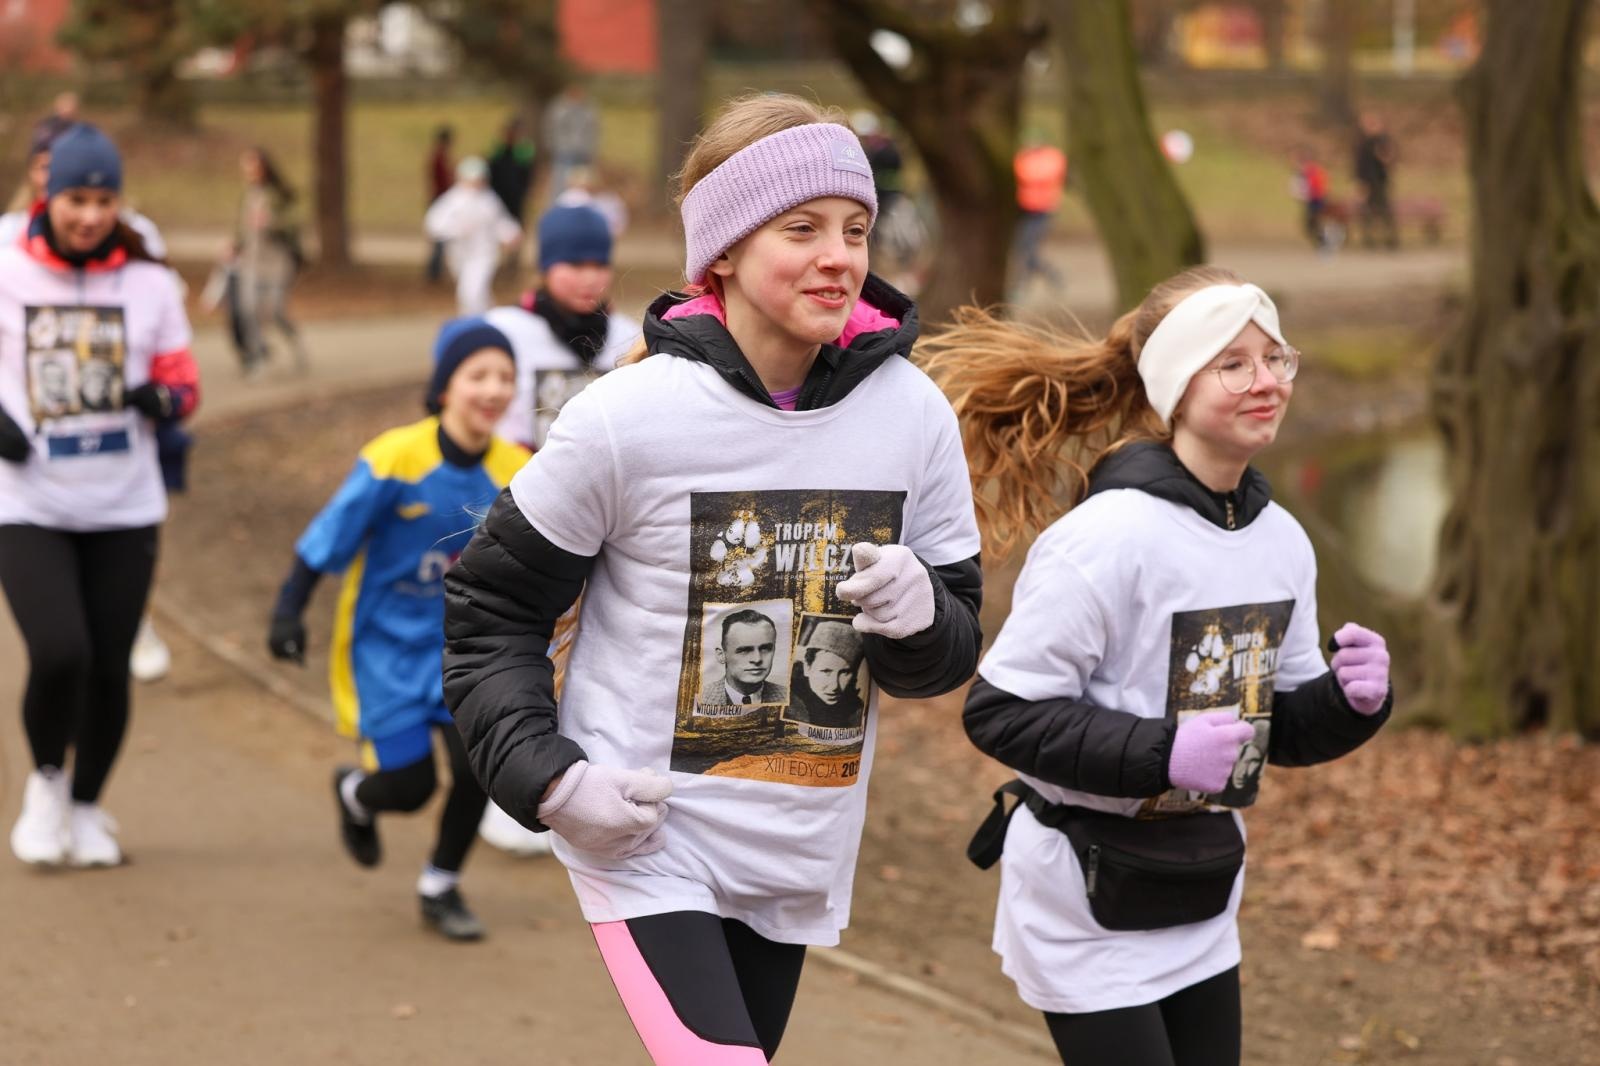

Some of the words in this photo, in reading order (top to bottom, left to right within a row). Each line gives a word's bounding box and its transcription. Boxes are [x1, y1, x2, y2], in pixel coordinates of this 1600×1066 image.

[775, 522, 837, 541] TROPEM
[775, 543, 853, 573] WILCZ
[696, 703, 718, 716] WITOLD
[719, 704, 743, 716] PILECKI
[808, 727, 833, 741] DANUTA
[764, 756, 785, 774] XIII
[789, 758, 839, 779] EDYCJA
